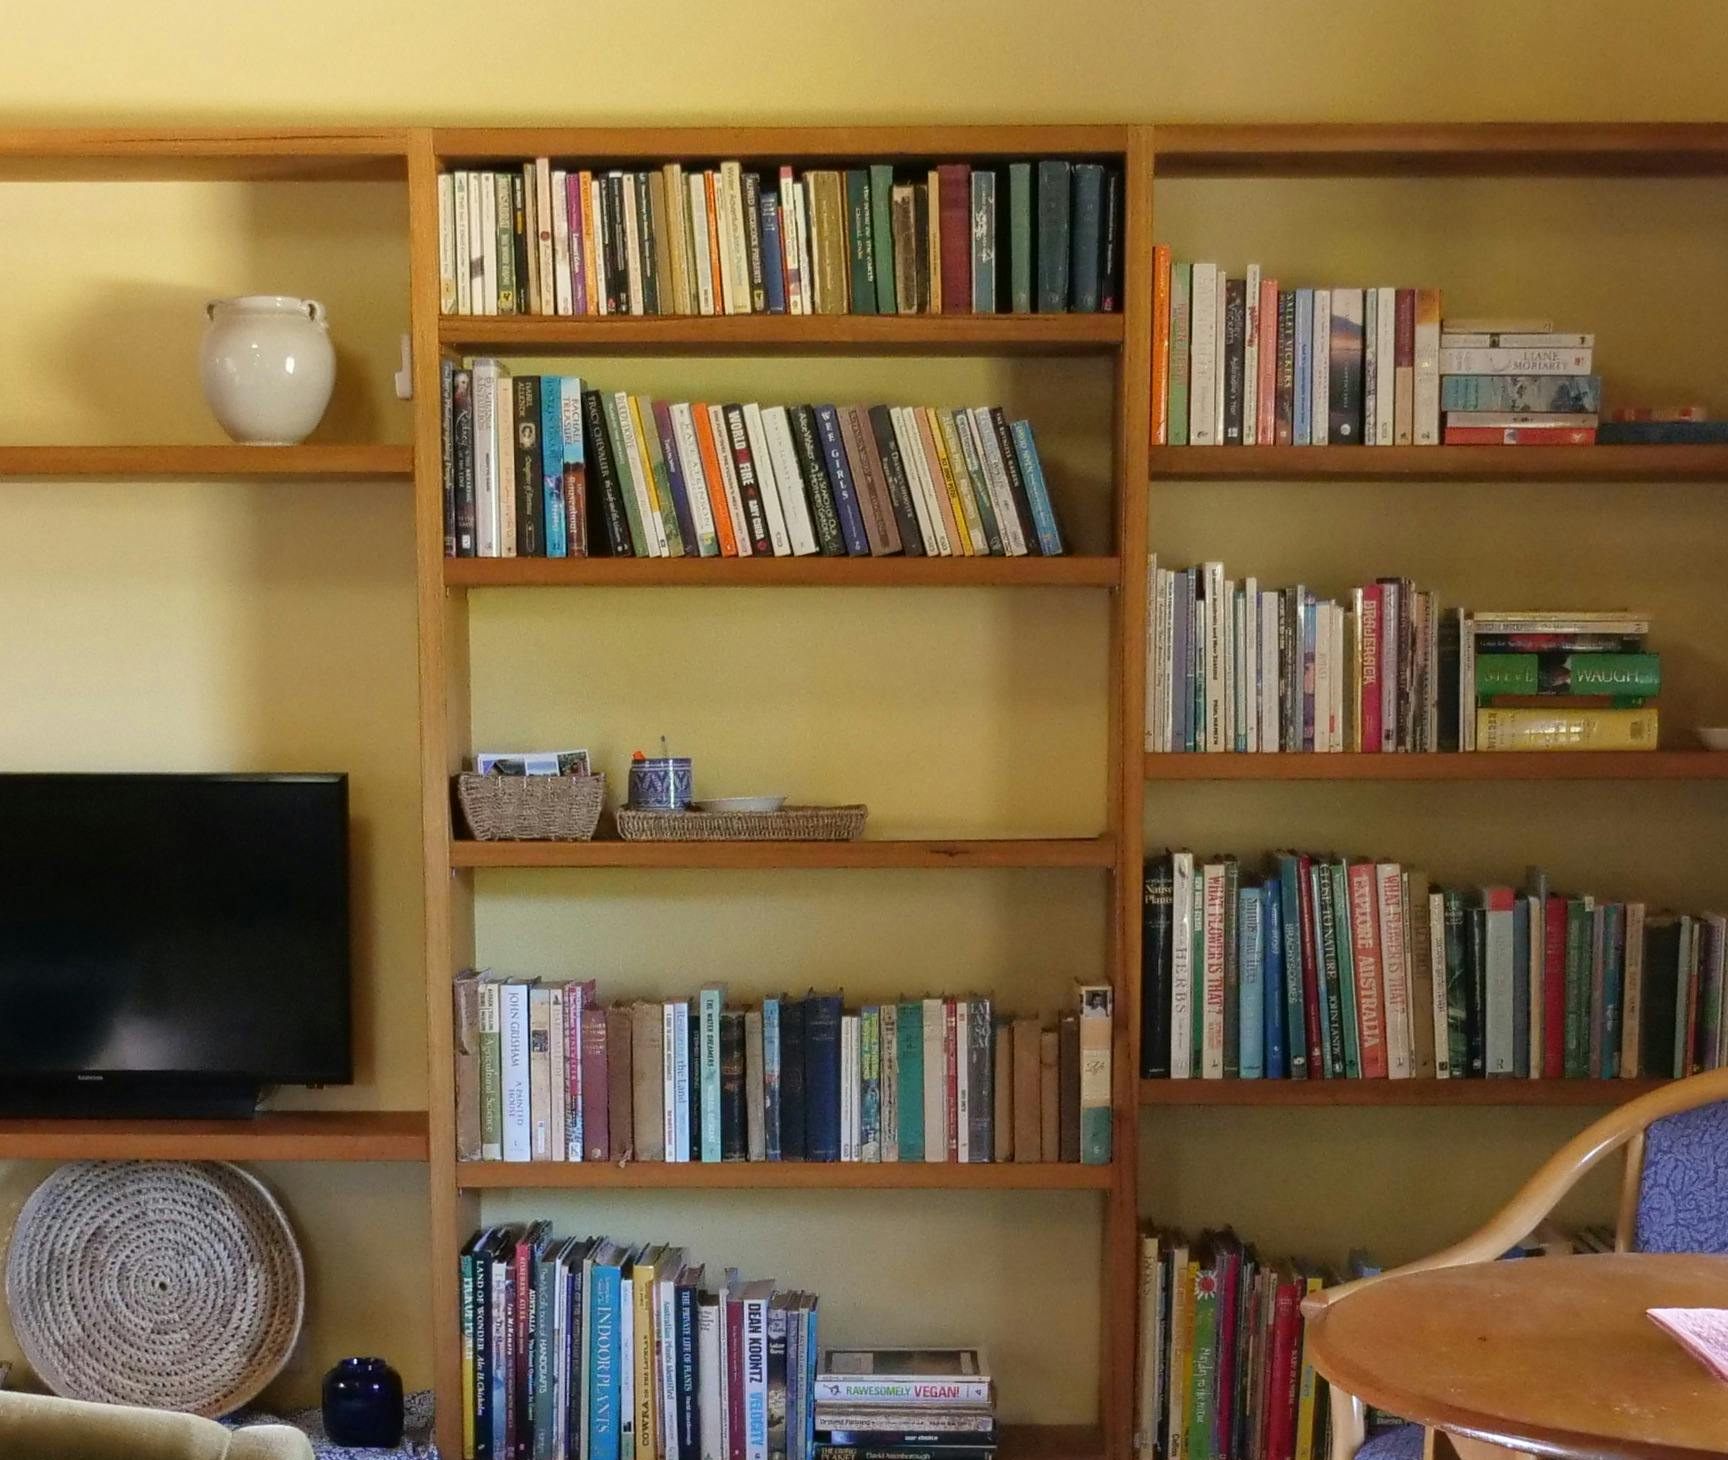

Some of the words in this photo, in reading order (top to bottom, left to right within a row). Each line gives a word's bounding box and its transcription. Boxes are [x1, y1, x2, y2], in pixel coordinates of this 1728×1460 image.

[745, 178, 755, 205] ALFRED
[748, 207, 759, 246] HITCHCOCK
[751, 247, 762, 284] PRESENTS
[1285, 293, 1294, 336] SALLEY
[1284, 340, 1294, 388] VICKERS
[1513, 361, 1568, 370] MORIARTY
[1523, 352, 1559, 361] LIANE
[564, 398, 572, 446] TREASURE
[572, 398, 580, 444] RACHAEL
[587, 396, 599, 425] TRACY
[593, 427, 609, 477] CHEVALIER
[799, 413, 810, 432] Alice
[728, 411, 746, 450] WORLD
[740, 463, 754, 486] FIRE
[802, 432, 815, 461] Walker
[749, 500, 760, 517] AMY
[1577, 671, 1639, 683] WAUGH
[1208, 877, 1224, 908] WHAT
[1319, 864, 1330, 905] CLOSE
[1385, 875, 1400, 907] WHAT
[1322, 910, 1331, 925] TO
[1354, 877, 1370, 948] EXPLORE
[1207, 913, 1224, 960] FLOWER
[1386, 912, 1402, 959] FLOWER
[1208, 963, 1224, 973] IS
[1325, 932, 1336, 980] NATURE
[1390, 963, 1404, 972] IS
[1176, 947, 1187, 1014] HERBS
[1208, 977, 1224, 1014] THAT?
[509, 992, 520, 1019] JOHN
[1329, 995, 1338, 1020] JOHN
[1359, 956, 1379, 1047] AUSTRALIA
[510, 1021, 520, 1067] GRISHAM
[484, 1038, 495, 1094] Agricultural
[677, 1060, 687, 1077] the
[508, 1089, 516, 1117] HOUSE
[678, 1079, 687, 1104] Land
[486, 1097, 496, 1132] Science
[477, 1291, 484, 1304] OF
[682, 1291, 690, 1306] THE
[540, 1329, 548, 1337] of
[663, 1301, 672, 1339] Australian
[683, 1307, 691, 1335] PRIVATE
[749, 1303, 761, 1334] DEAN
[597, 1306, 612, 1371] INDOOR
[664, 1340, 673, 1364] Plants
[683, 1336, 691, 1351] LIFE
[539, 1339, 548, 1394] HANDCRAFTS
[683, 1352, 691, 1362] OF
[749, 1337, 763, 1383] KOONTZ
[665, 1364, 674, 1399] Identified
[683, 1364, 692, 1391] PLANTS
[846, 1386, 911, 1396] RAWESOMELY
[914, 1385, 960, 1398] VEGAN!
[596, 1373, 610, 1432] PLANTS
[751, 1392, 764, 1445] VELOCITY
[642, 1401, 650, 1446] COWRA
